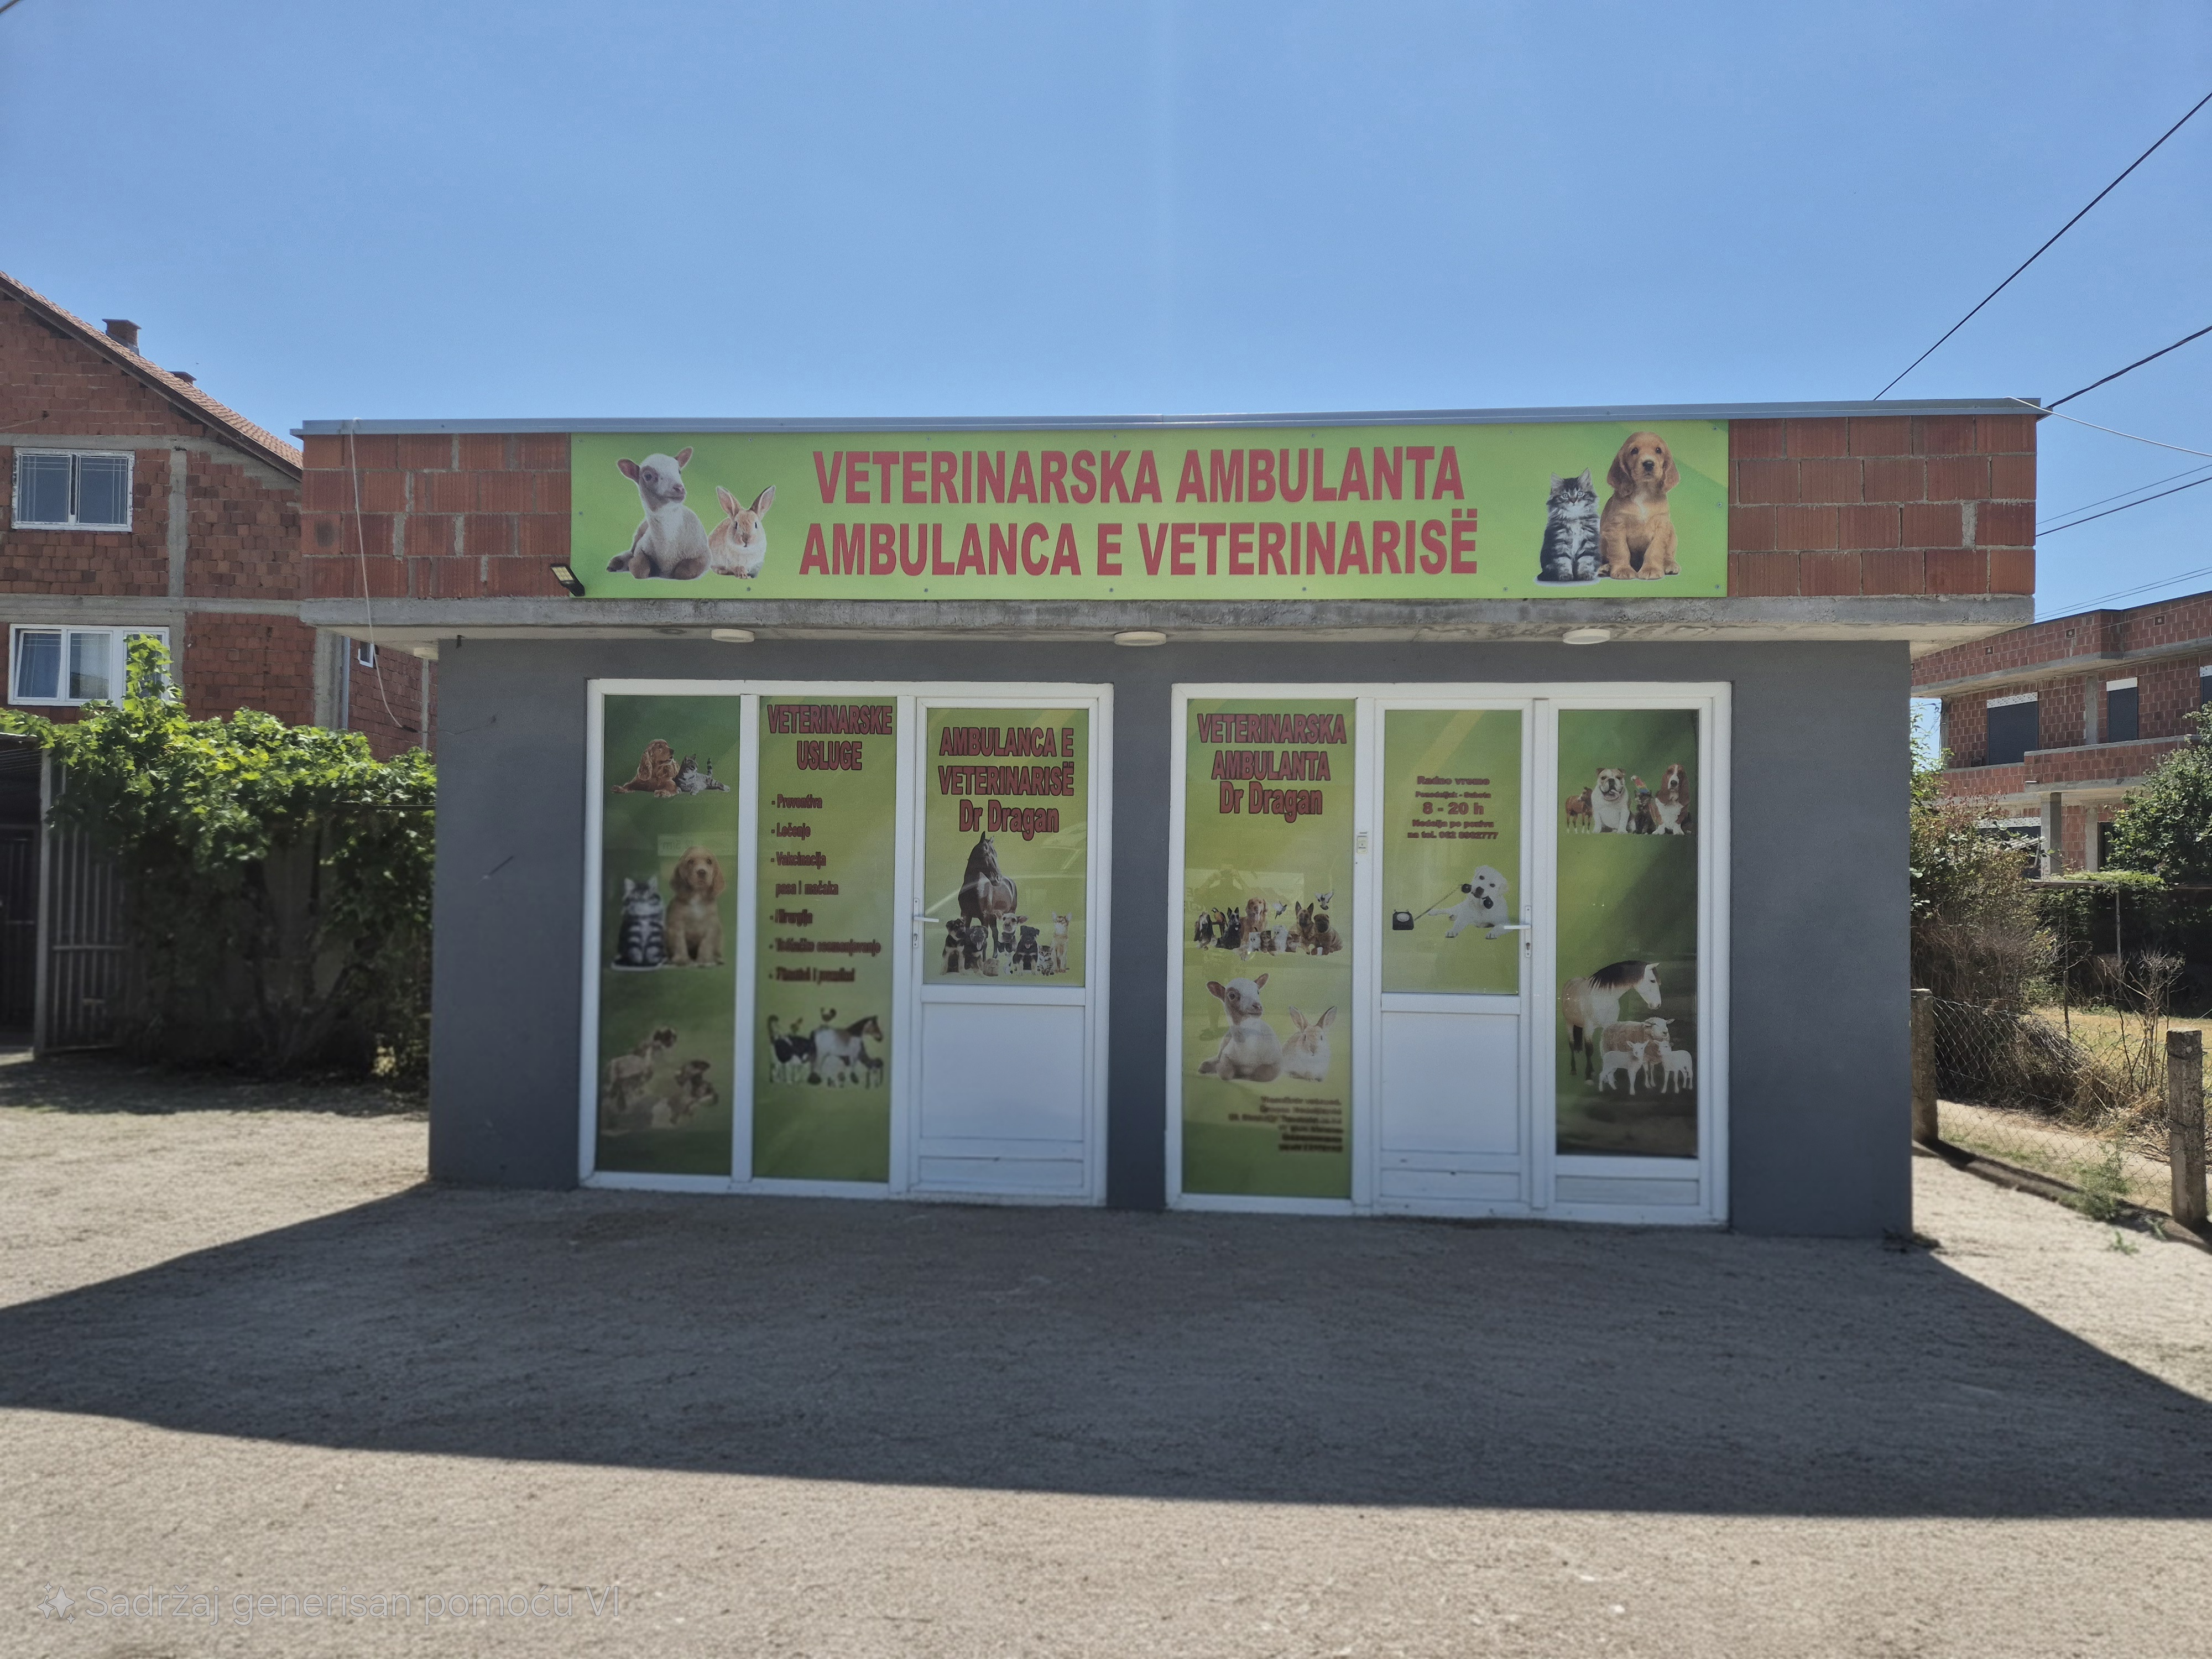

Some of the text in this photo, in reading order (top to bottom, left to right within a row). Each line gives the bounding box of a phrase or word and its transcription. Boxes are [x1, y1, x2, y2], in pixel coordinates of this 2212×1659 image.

[813, 446, 1465, 504] VETERINARSKA AMBULANTA
[799, 508, 1478, 576] AMBULANCA E VETERINARISË
[767, 704, 893, 735] VETERINARSKE
[1197, 713, 1347, 744] VETERINARSKA
[796, 740, 863, 771] USLUGE
[939, 727, 1074, 757] AMBULANCA E
[938, 761, 1074, 796] VETERINARISË
[1211, 750, 1331, 781] AMBULANTA
[1219, 781, 1323, 823] Dr Dragan
[1422, 802, 1433, 815] 8
[1448, 802, 1469, 815] 20
[1473, 802, 1484, 815] h
[959, 799, 1060, 841] Dr Dragan
